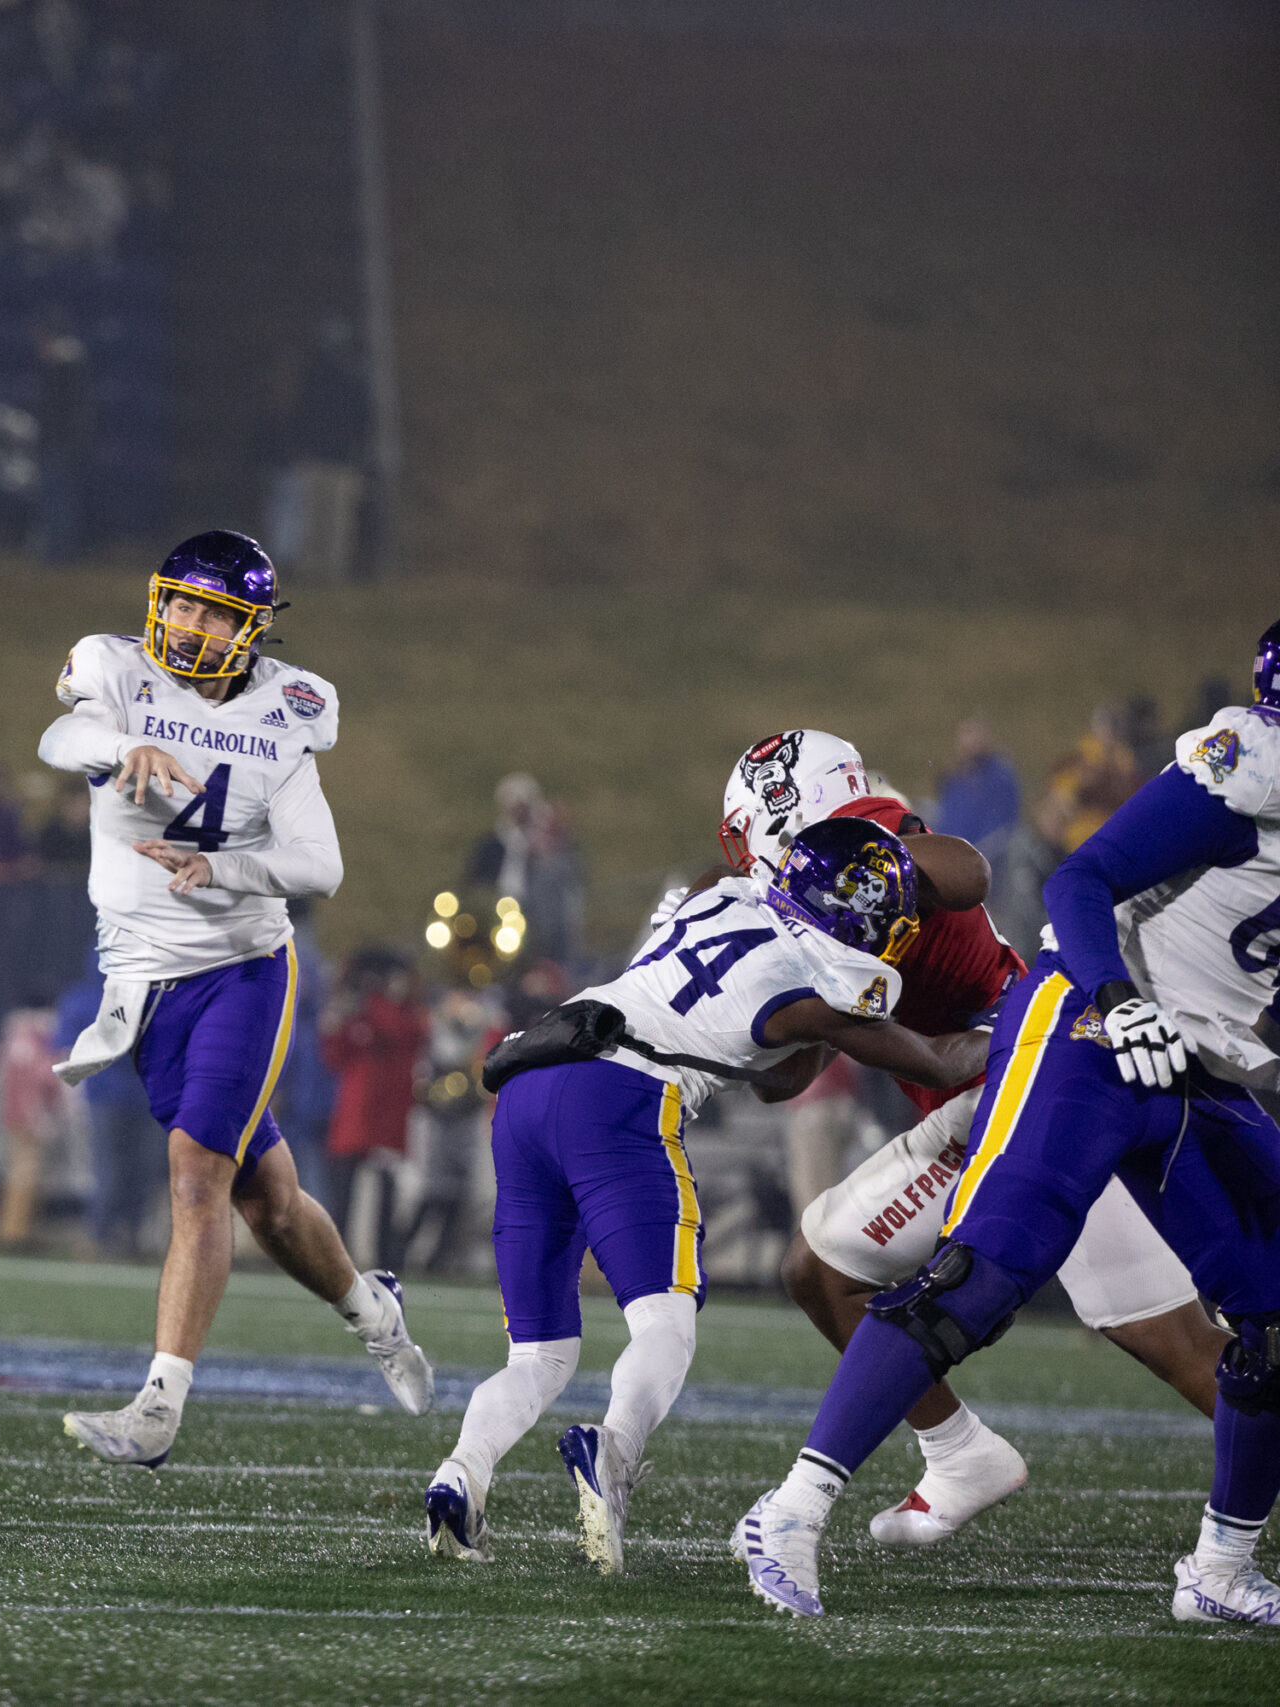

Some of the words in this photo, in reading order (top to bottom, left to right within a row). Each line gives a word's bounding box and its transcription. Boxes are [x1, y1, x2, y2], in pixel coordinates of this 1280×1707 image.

[142, 715, 189, 743] EAST
[190, 726, 279, 761] CAROLINA
[752, 750, 762, 760] NC
[761, 739, 779, 753] STATE
[163, 763, 232, 853] 4
[868, 856, 892, 873] ECU
[861, 1135, 968, 1247] WOLFPACK
